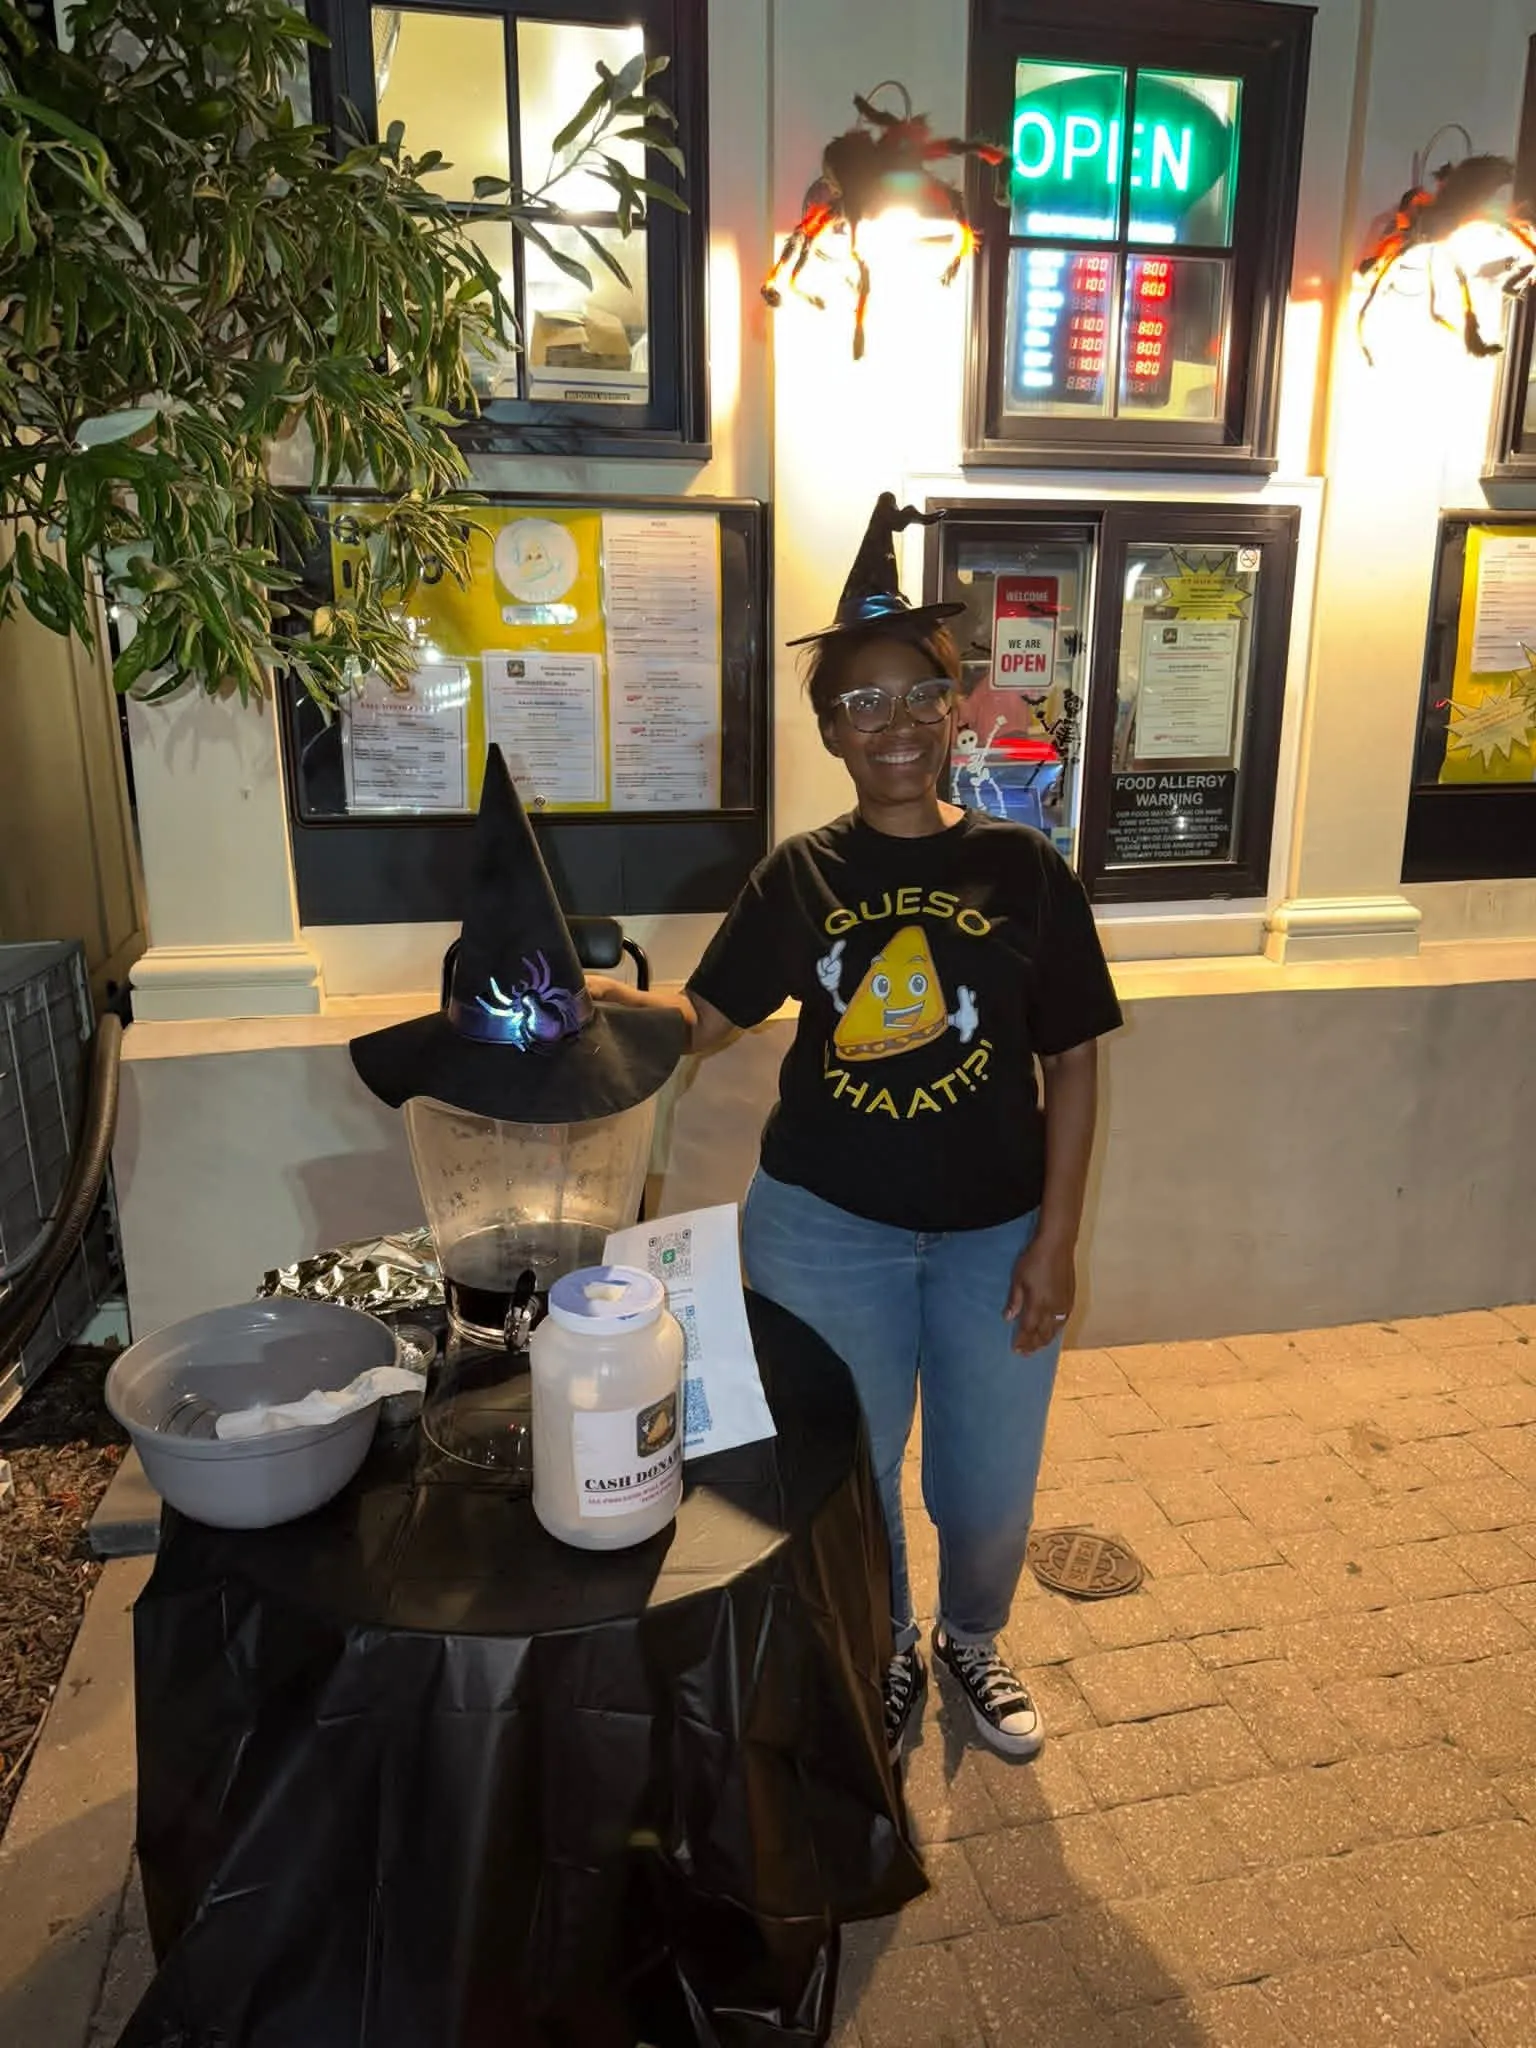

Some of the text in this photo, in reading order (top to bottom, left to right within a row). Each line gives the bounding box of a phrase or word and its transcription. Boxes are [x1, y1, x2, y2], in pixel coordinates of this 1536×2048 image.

[1013, 110, 1193, 193] OPEN
[1005, 590, 1050, 602] WELCOME
[1008, 638, 1042, 649] WE ARE
[1001, 653, 1047, 673] OPEN
[1115, 774, 1228, 791] FOOD ALLERGY
[1135, 792, 1204, 807] WARNING
[824, 886, 992, 937] QUESO
[584, 1475, 631, 1490] CASH
